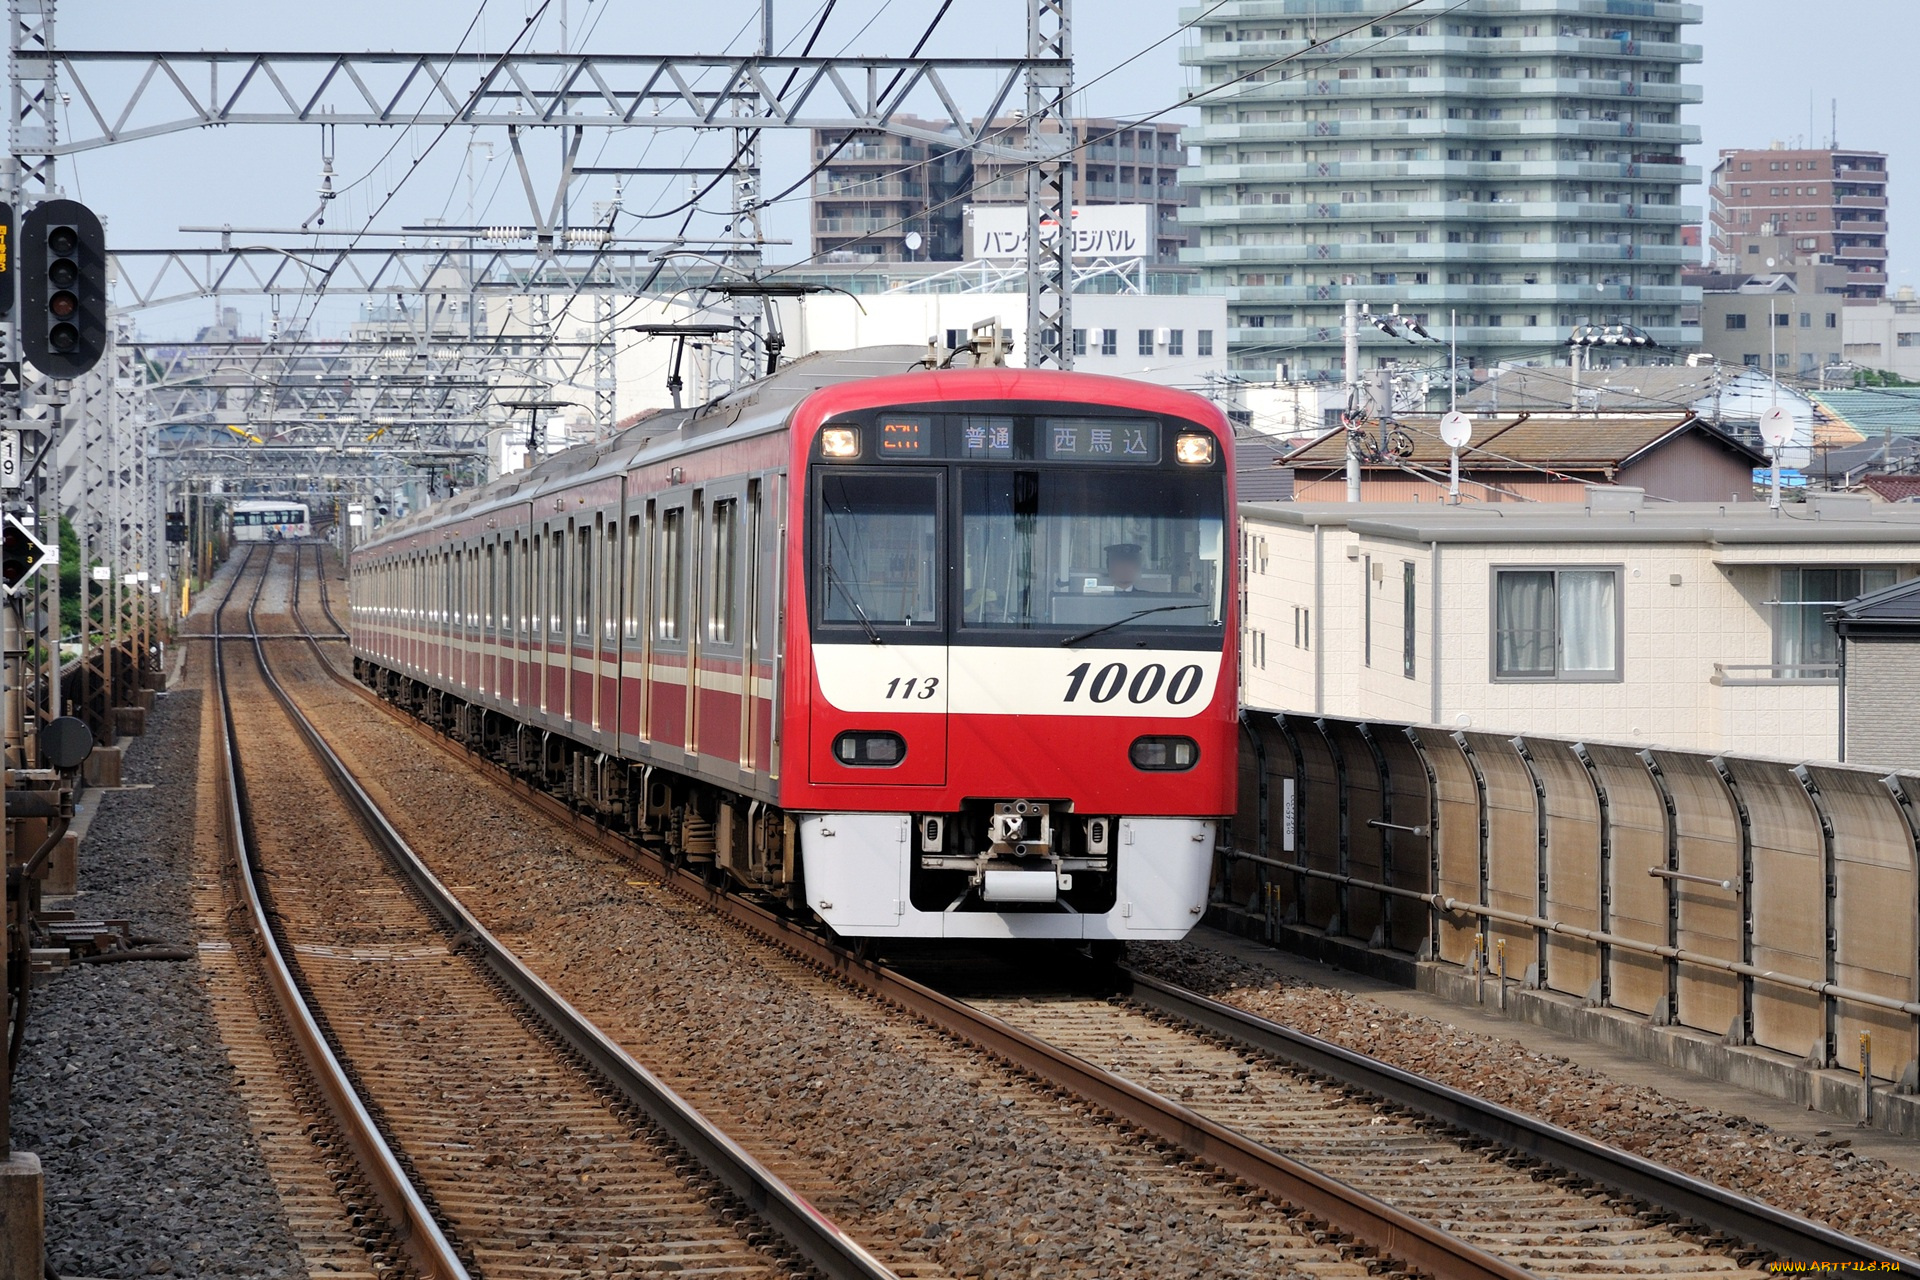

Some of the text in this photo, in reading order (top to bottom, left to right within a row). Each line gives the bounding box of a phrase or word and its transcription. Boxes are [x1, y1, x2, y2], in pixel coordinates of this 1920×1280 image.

[965, 426, 1010, 450] 普通
[1053, 427, 1148, 454] 西馬込
[885, 677, 940, 700] 113
[1063, 662, 1204, 705] 1000
